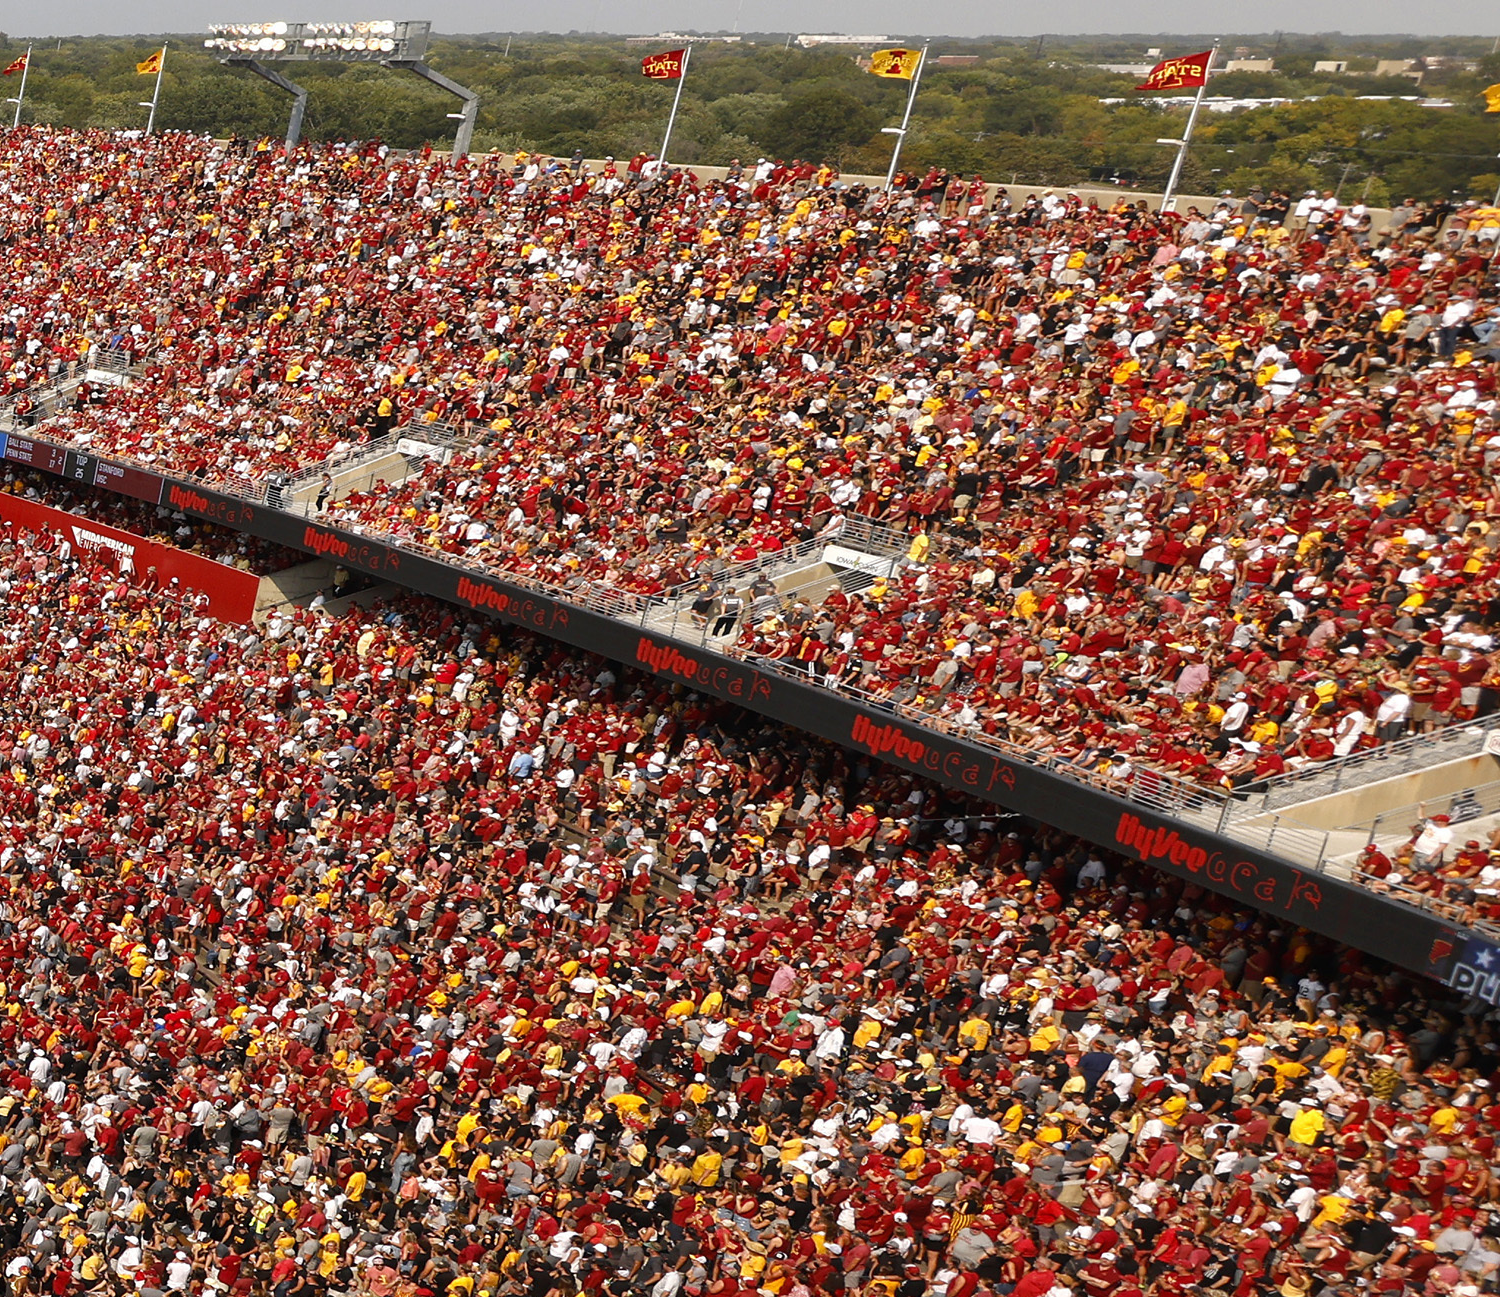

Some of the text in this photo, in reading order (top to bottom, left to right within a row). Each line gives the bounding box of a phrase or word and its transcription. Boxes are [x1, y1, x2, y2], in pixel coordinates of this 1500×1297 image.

[8, 436, 34, 451] BALL STATE
[6, 447, 33, 463] PENN STATE
[51, 448, 56, 457] 3
[49, 459, 55, 468] 17
[58, 456, 63, 465] 2
[76, 455, 88, 467] TOP
[74, 467, 84, 479] 25
[99, 462, 124, 478] STANFORD
[80, 528, 135, 556] MIDAMERICAN
[836, 556, 854, 565] IOWA
